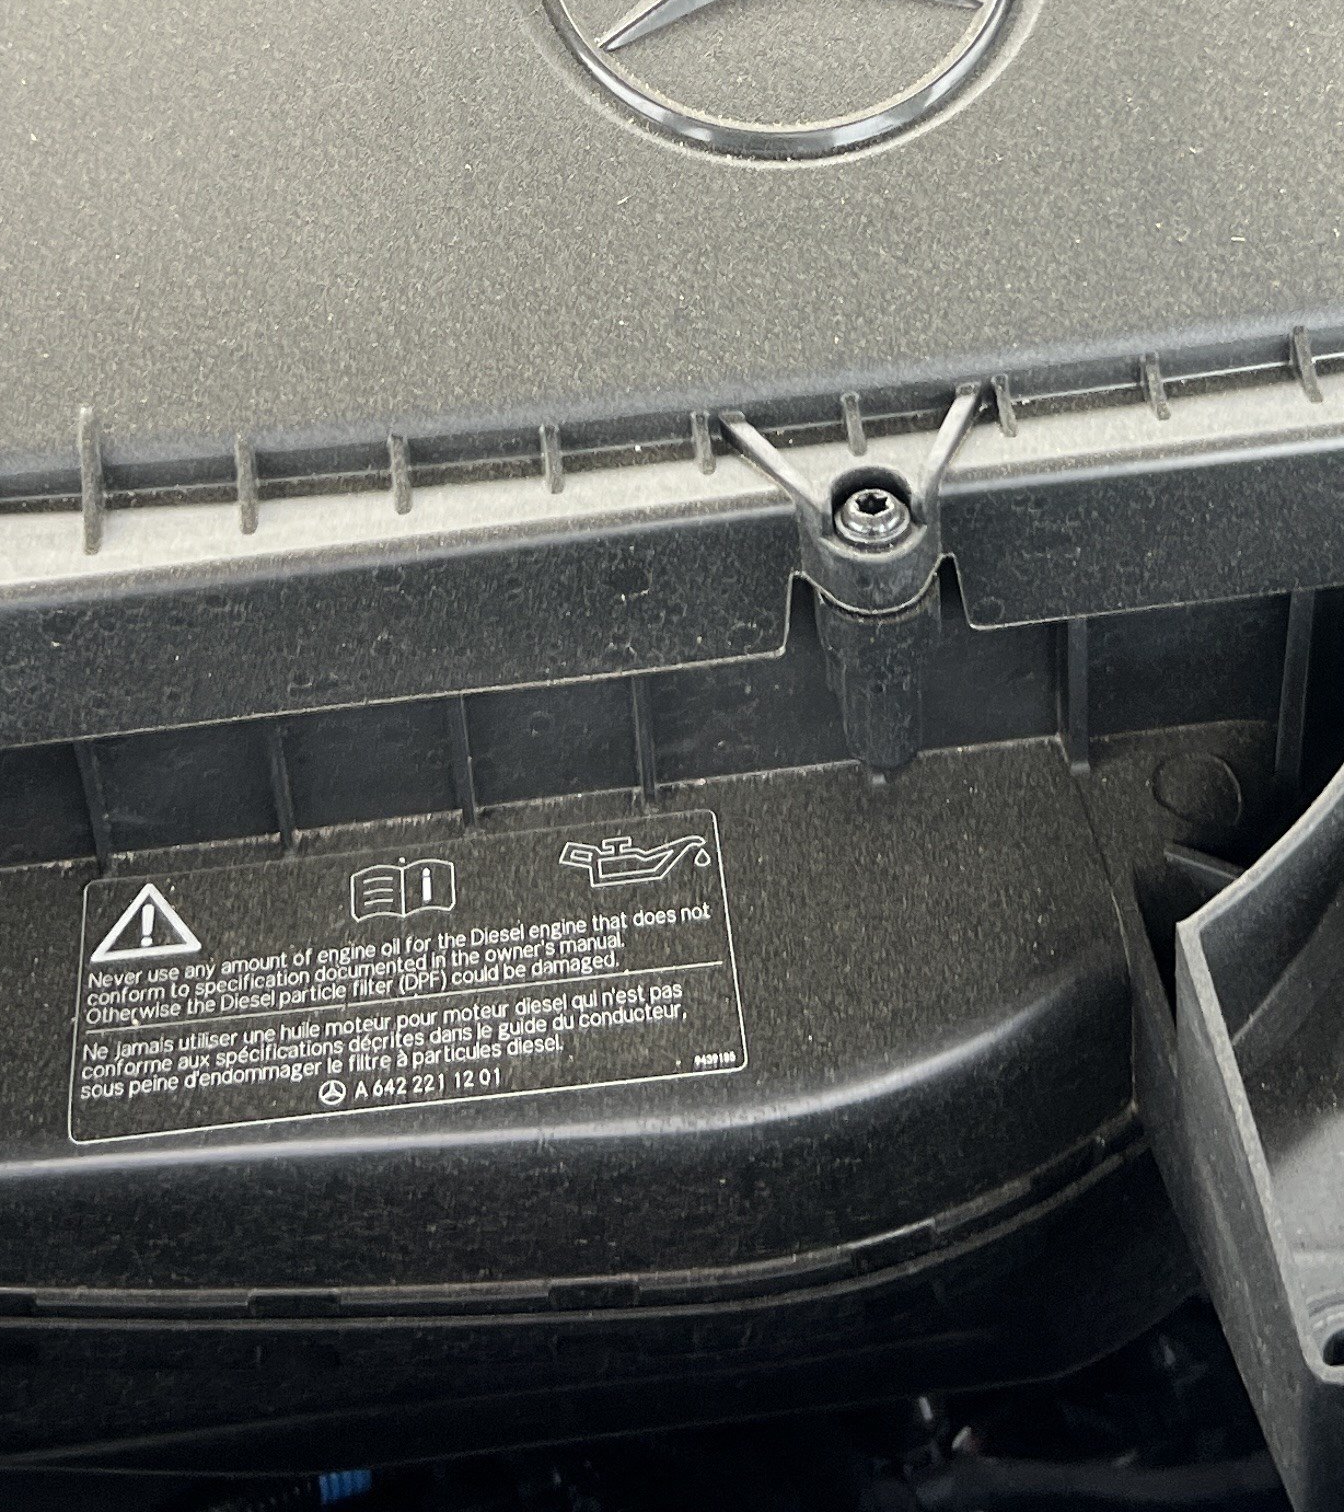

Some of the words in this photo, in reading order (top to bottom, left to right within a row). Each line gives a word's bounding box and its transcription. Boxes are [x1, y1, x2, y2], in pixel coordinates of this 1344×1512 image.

[87, 986, 166, 1007] conform
[170, 982, 190, 999] to
[194, 969, 310, 998] specification
[314, 954, 427, 983] documented
[431, 949, 447, 970] in
[451, 948, 480, 968] the
[484, 939, 556, 964] owner's
[559, 930, 625, 955] manual.
[88, 970, 143, 989] Never
[147, 967, 180, 983] use
[184, 963, 216, 981] any
[220, 951, 288, 975] amount
[292, 947, 313, 968] of
[317, 943, 376, 968] engine
[380, 937, 401, 959] oil
[405, 935, 432, 955] for
[437, 931, 467, 951] the
[470, 923, 525, 948] Diesel
[528, 918, 588, 942] engine
[591, 911, 628, 934] that
[632, 908, 677, 928] does
[680, 900, 711, 923] not
[82, 1041, 109, 1061] Ne
[113, 1036, 174, 1062] jamais
[178, 1031, 239, 1052] utiliser
[243, 1027, 276, 1048] une
[280, 1019, 321, 1041] huile
[324, 1015, 392, 1038] moteur
[396, 1010, 439, 1034] pour
[443, 1003, 510, 1025] moteur
[514, 993, 568, 1017] diesel
[571, 988, 598, 1014] qui
[601, 984, 646, 1008] n'est
[649, 982, 683, 1005] pas
[86, 1001, 182, 1024] Otherwise
[186, 997, 212, 1015] the
[220, 989, 276, 1013] Diesel
[278, 982, 347, 1010] particle
[352, 978, 394, 997] filter
[398, 968, 447, 996] (DPF)
[451, 963, 500, 986] could
[503, 962, 527, 981] be
[531, 949, 620, 978] damaged.
[80, 1081, 125, 1101] sous
[128, 1075, 179, 1099] peine
[184, 1061, 323, 1089] d'endommager
[327, 1056, 343, 1075] le
[348, 1052, 392, 1073] filtre
[396, 1048, 409, 1069] à
[412, 1041, 502, 1070] particules
[506, 1032, 564, 1056] diesel.
[81, 1057, 173, 1080] conforme
[177, 1054, 210, 1071] aux
[215, 1039, 344, 1068] spécifications
[348, 1029, 425, 1054] décrites
[429, 1025, 473, 1046] dans
[476, 1021, 493, 1041] le
[497, 1015, 548, 1042] guide
[552, 1012, 575, 1032] du
[578, 1002, 687, 1029] conducteur,
[354, 1080, 369, 1100] A
[372, 1075, 407, 1098] 642
[412, 1072, 445, 1095] 221
[454, 1069, 475, 1089] 12
[478, 1066, 500, 1087] 01
